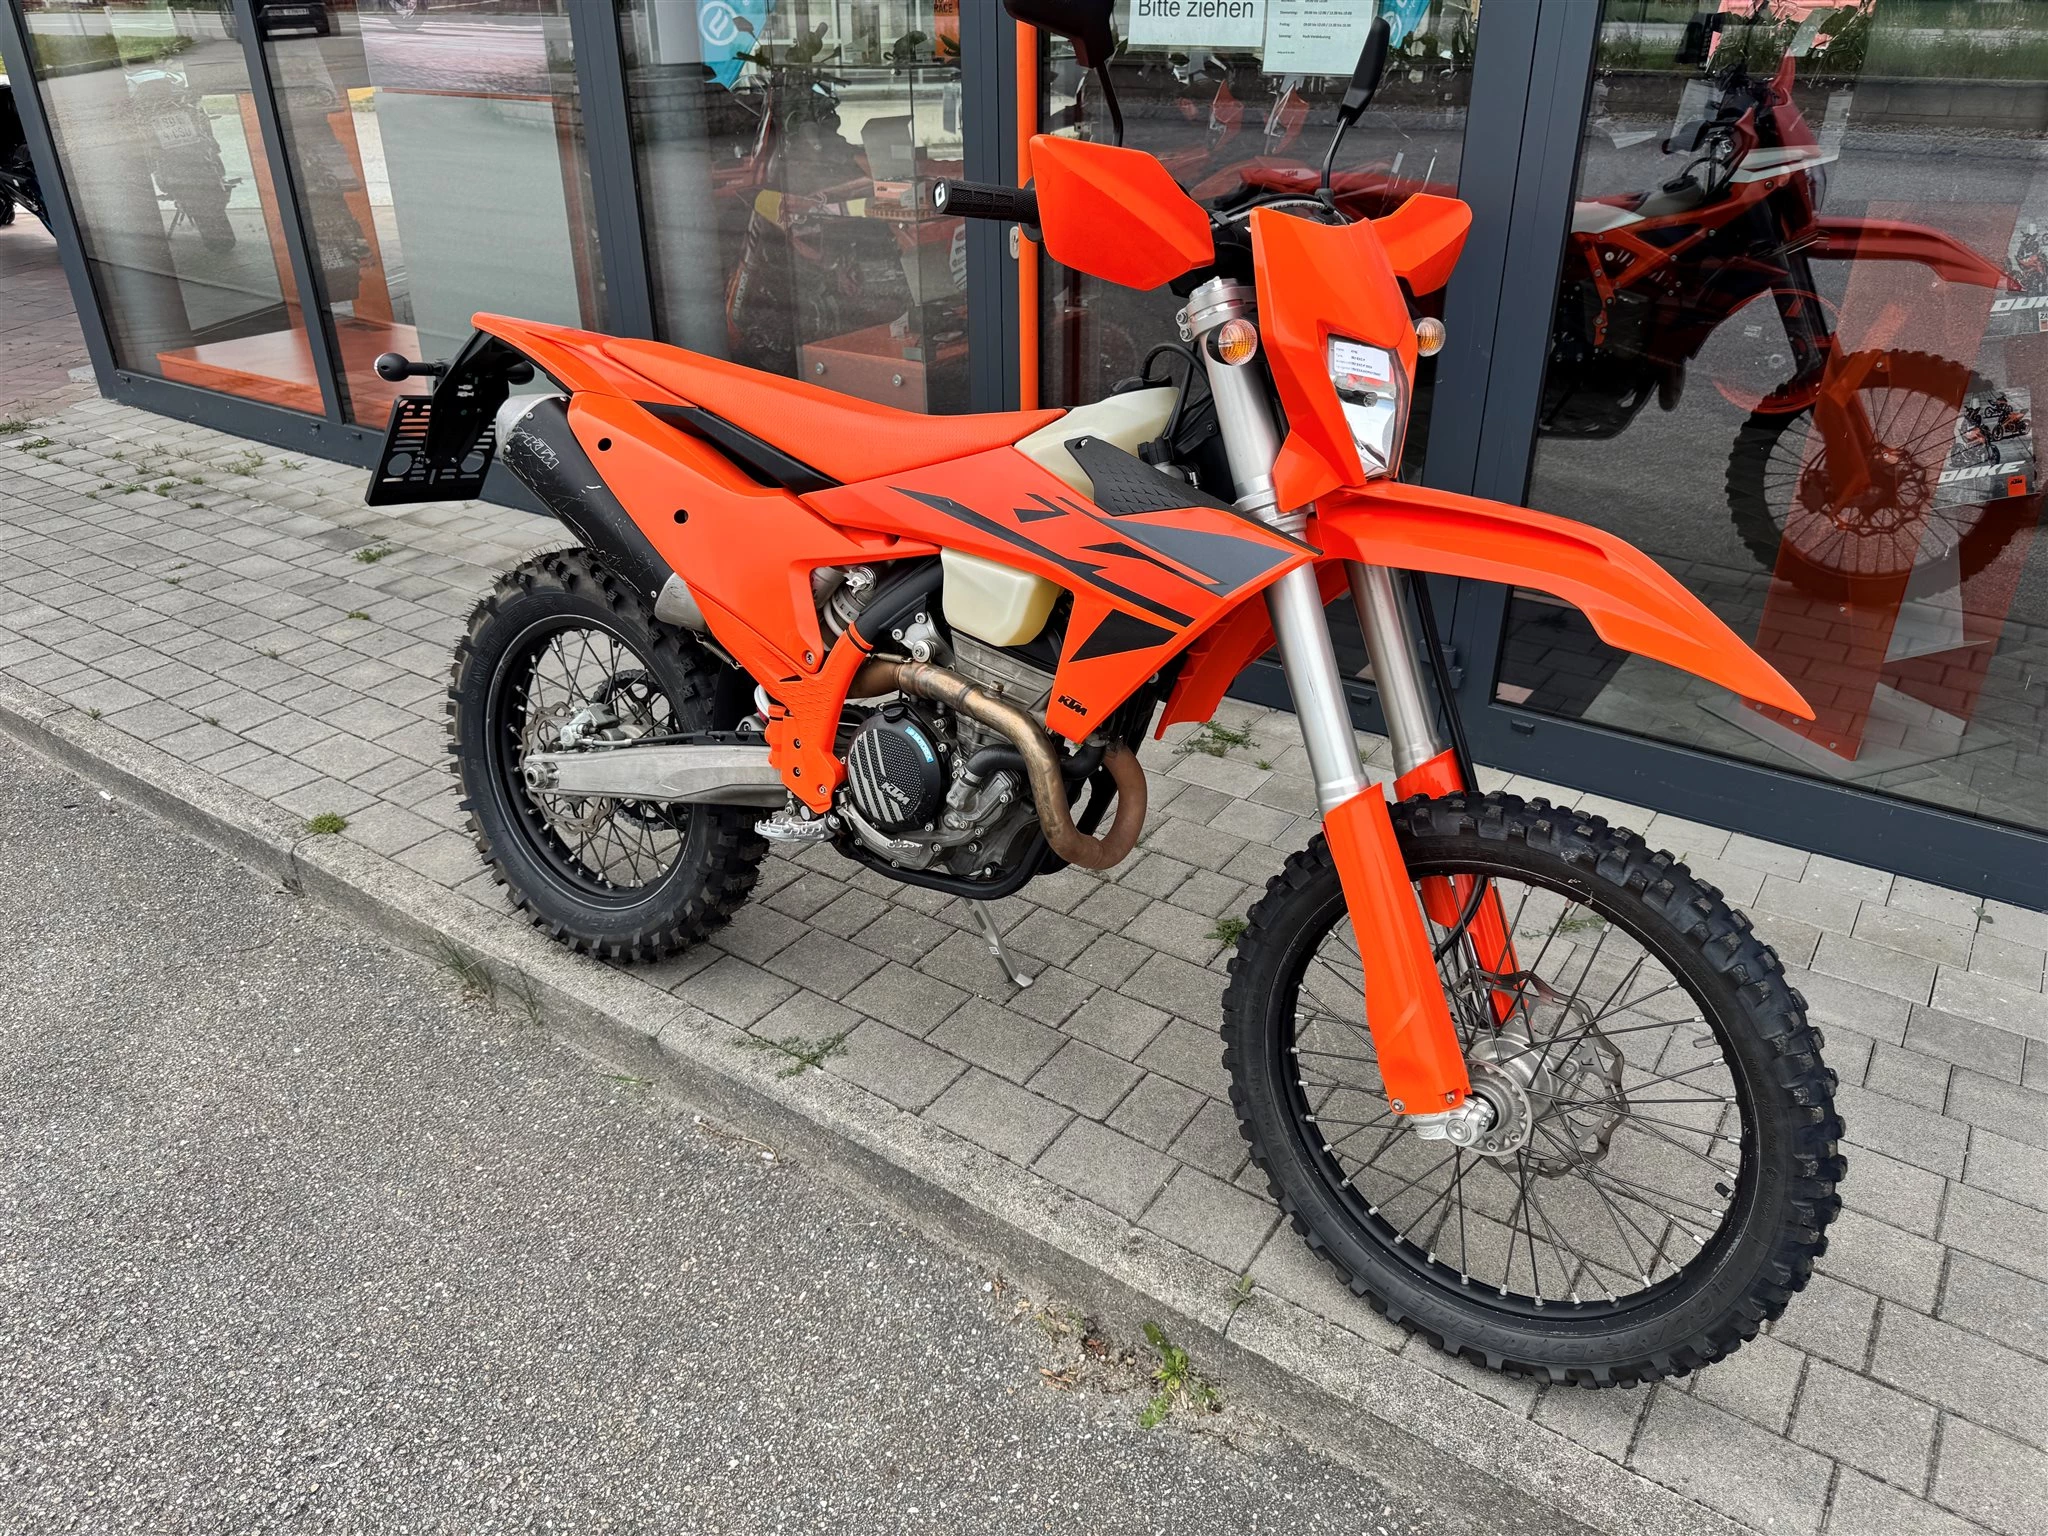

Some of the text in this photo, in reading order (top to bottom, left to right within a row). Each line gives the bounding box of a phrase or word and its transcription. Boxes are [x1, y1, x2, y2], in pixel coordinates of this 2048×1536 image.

[1138, 0, 1254, 18] Bitte ziehen
[524, 436, 560, 470] KTM
[1937, 460, 2026, 484] DUKE
[1057, 695, 1088, 716] KTM
[881, 782, 911, 805] KTM
